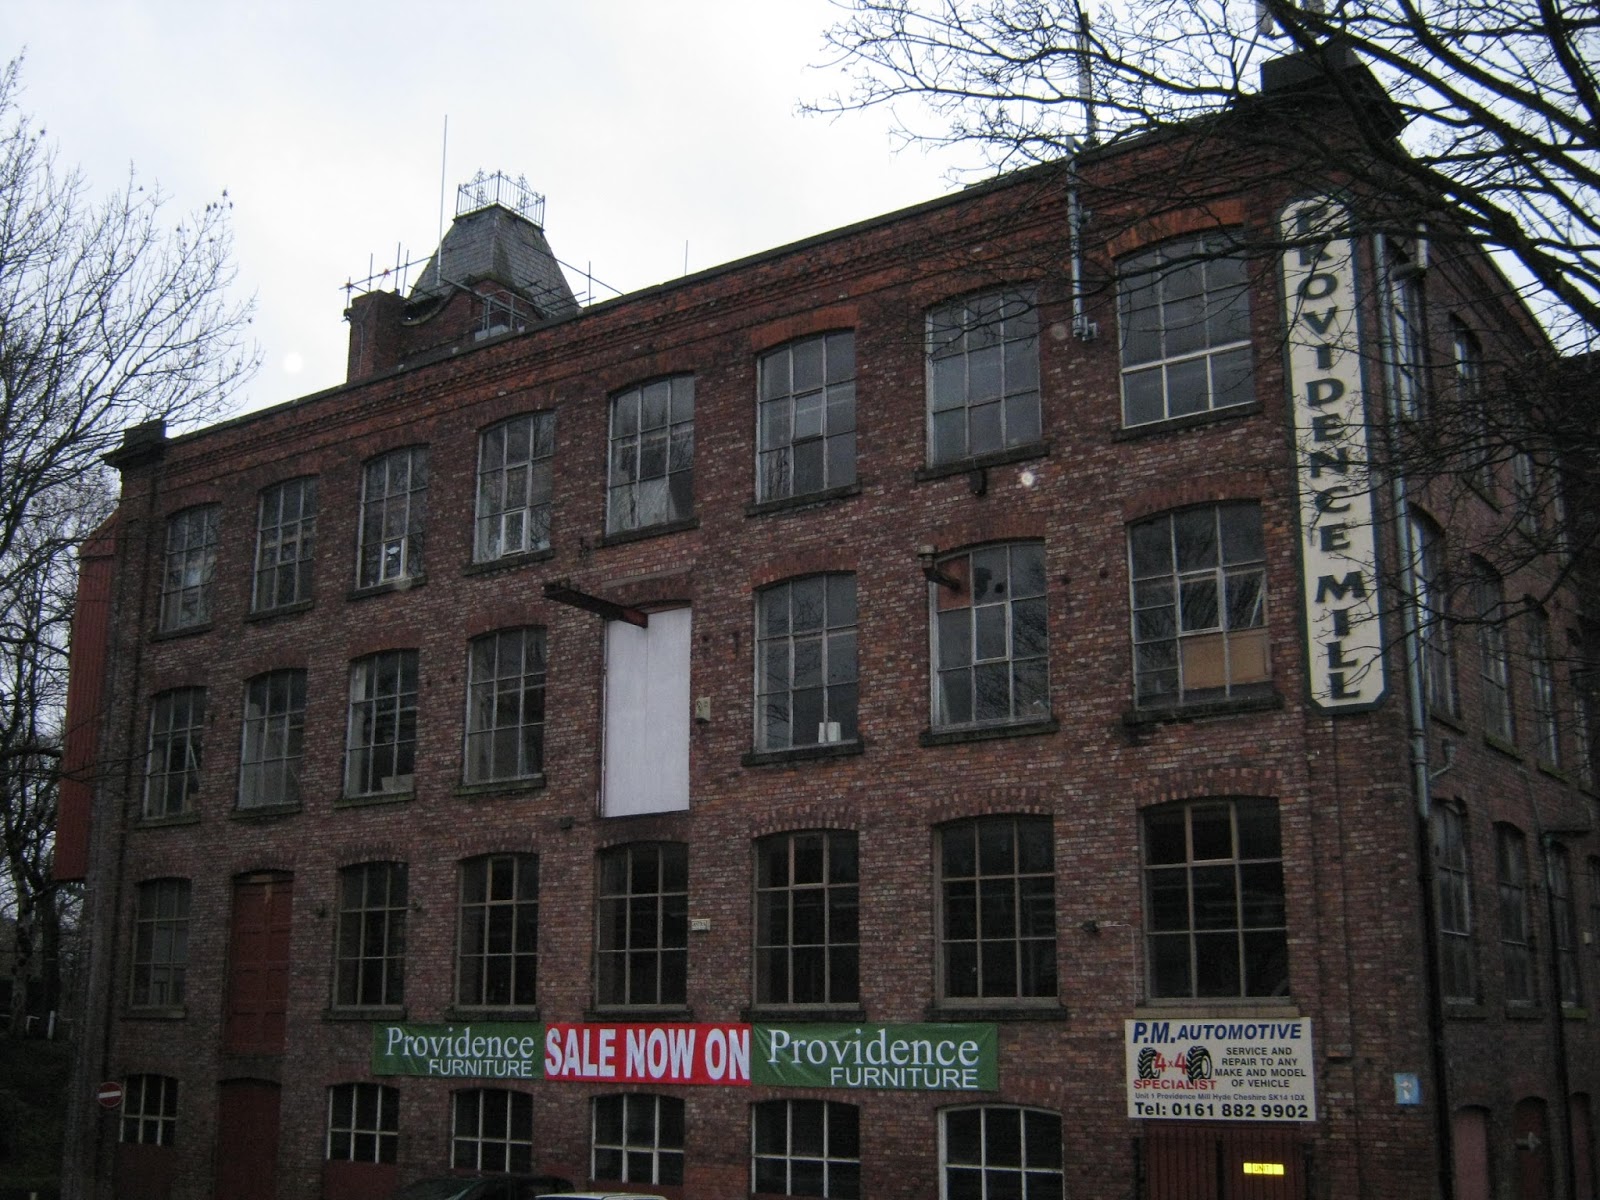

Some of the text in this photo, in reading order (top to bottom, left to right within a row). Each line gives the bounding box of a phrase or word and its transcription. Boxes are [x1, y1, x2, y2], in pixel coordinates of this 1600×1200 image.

[1296, 205, 1367, 699] PROVIDENCE MILL
[1177, 1023, 1302, 1041] AUTOMOTIVE
[385, 1026, 535, 1059] Providence
[767, 1028, 979, 1067] Providence
[1226, 1047, 1293, 1056] SERVICE AND
[544, 1027, 750, 1080] SALE NOW ON
[1221, 1057, 1298, 1066] REPAIR TO ANY
[429, 1059, 533, 1077] FURNITURE
[1154, 1051, 1188, 1075] 4x4
[830, 1066, 979, 1089] FURNITURE
[1214, 1068, 1306, 1077] MAKE AND MODEL
[1133, 1079, 1217, 1090] SPECIALIST
[1231, 1079, 1290, 1088] OF VEHICLE
[1135, 1092, 1150, 1100] Unit
[1212, 1094, 1232, 1102] Hyde
[1233, 1093, 1267, 1101] Cheshire
[1134, 1102, 1308, 1118] Tel: 0161 882 9902
